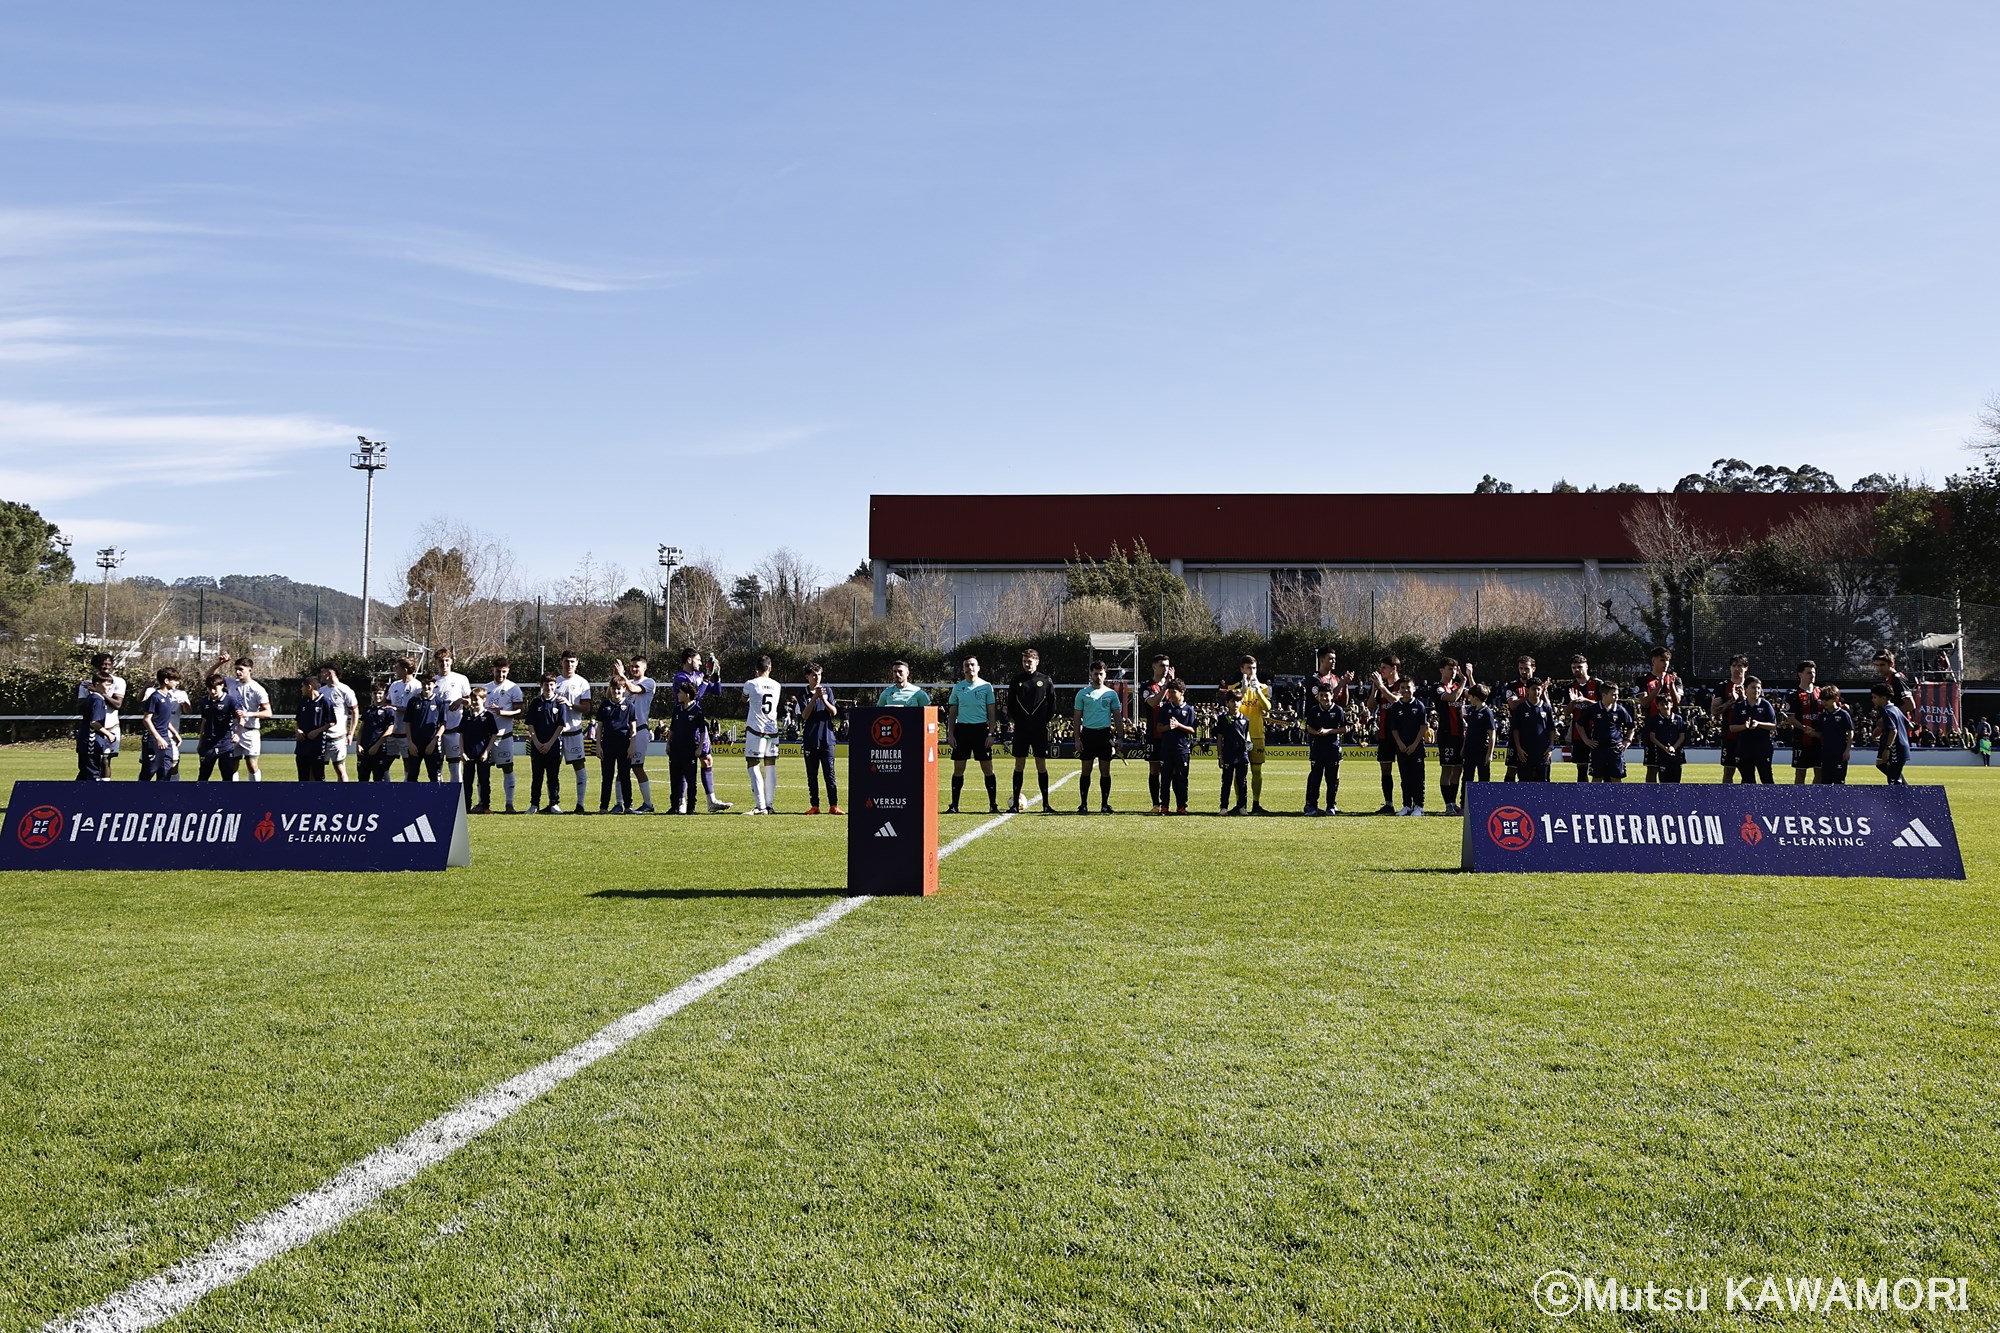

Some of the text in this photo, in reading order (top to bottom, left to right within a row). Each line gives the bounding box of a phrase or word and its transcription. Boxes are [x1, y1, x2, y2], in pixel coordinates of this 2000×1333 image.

[762, 693, 773, 715] 5
[1919, 705, 1953, 715] ARENAS
[1925, 715, 1948, 724] CLUB
[1146, 744, 1154, 753] 21
[1445, 748, 1454, 756] 23
[871, 750, 902, 759] PRIMERA
[96, 809, 242, 843] FEDERACIÓN
[281, 814, 380, 832] VERSUS
[1571, 810, 1725, 845] FEDERACIÓN
[1762, 816, 1871, 835] VERSUS
[288, 834, 367, 843] E-LEARNING
[1779, 837, 1865, 847] E-LEARNING
